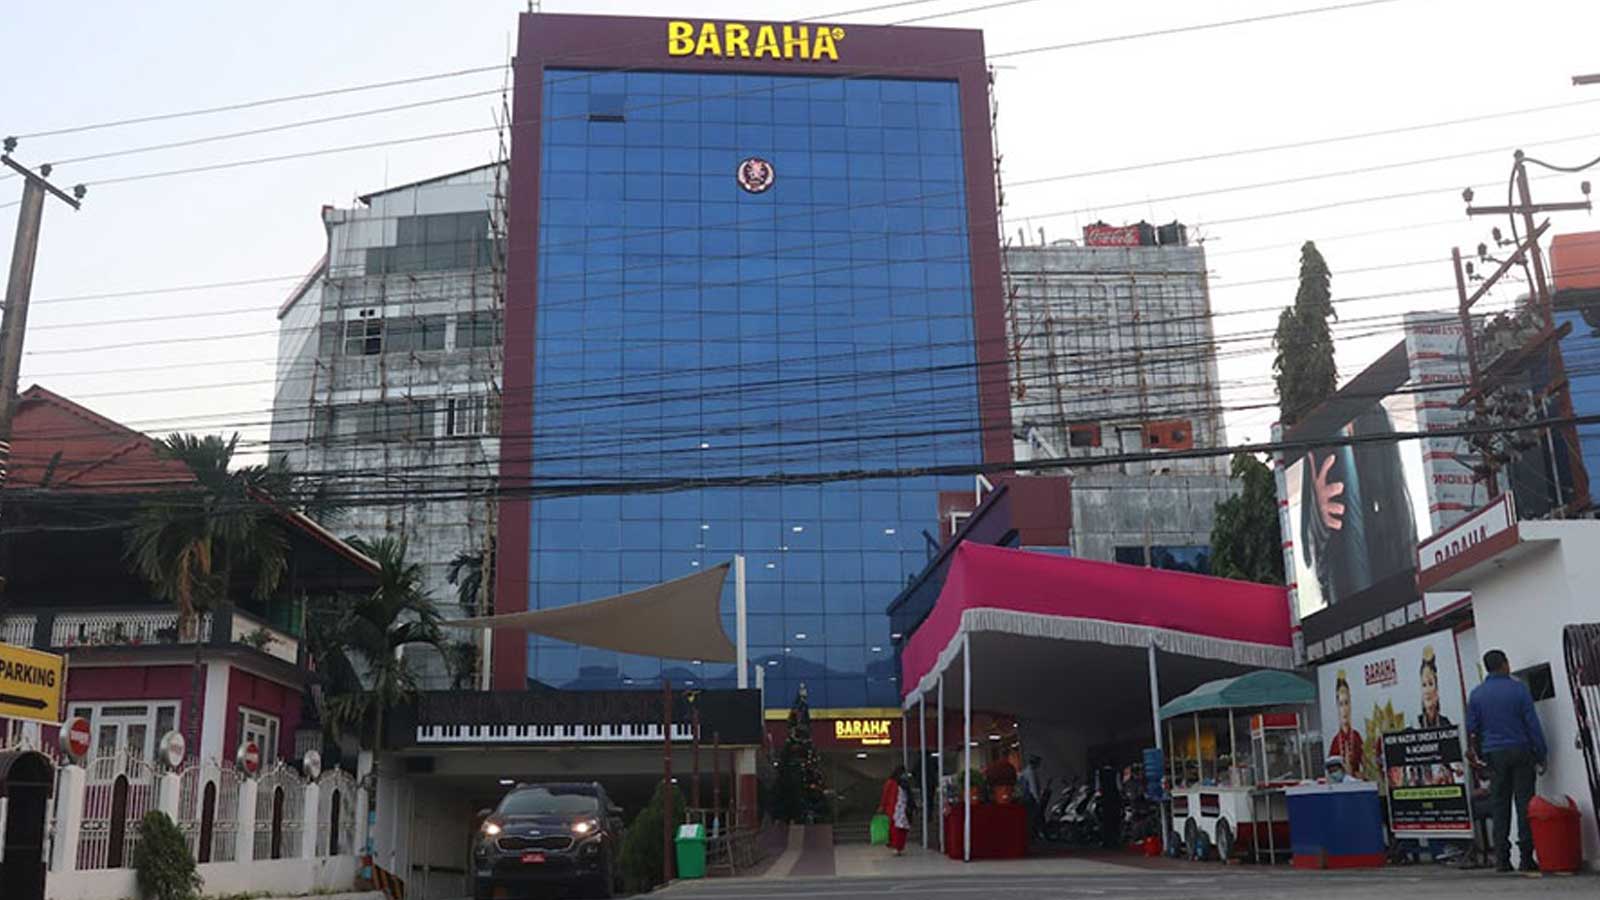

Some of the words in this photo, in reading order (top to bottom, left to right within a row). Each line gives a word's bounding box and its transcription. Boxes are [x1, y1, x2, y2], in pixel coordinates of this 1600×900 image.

[668, 21, 839, 60] BARAHA
[0, 659, 55, 688] PARKING
[835, 720, 889, 736] BARAHA
